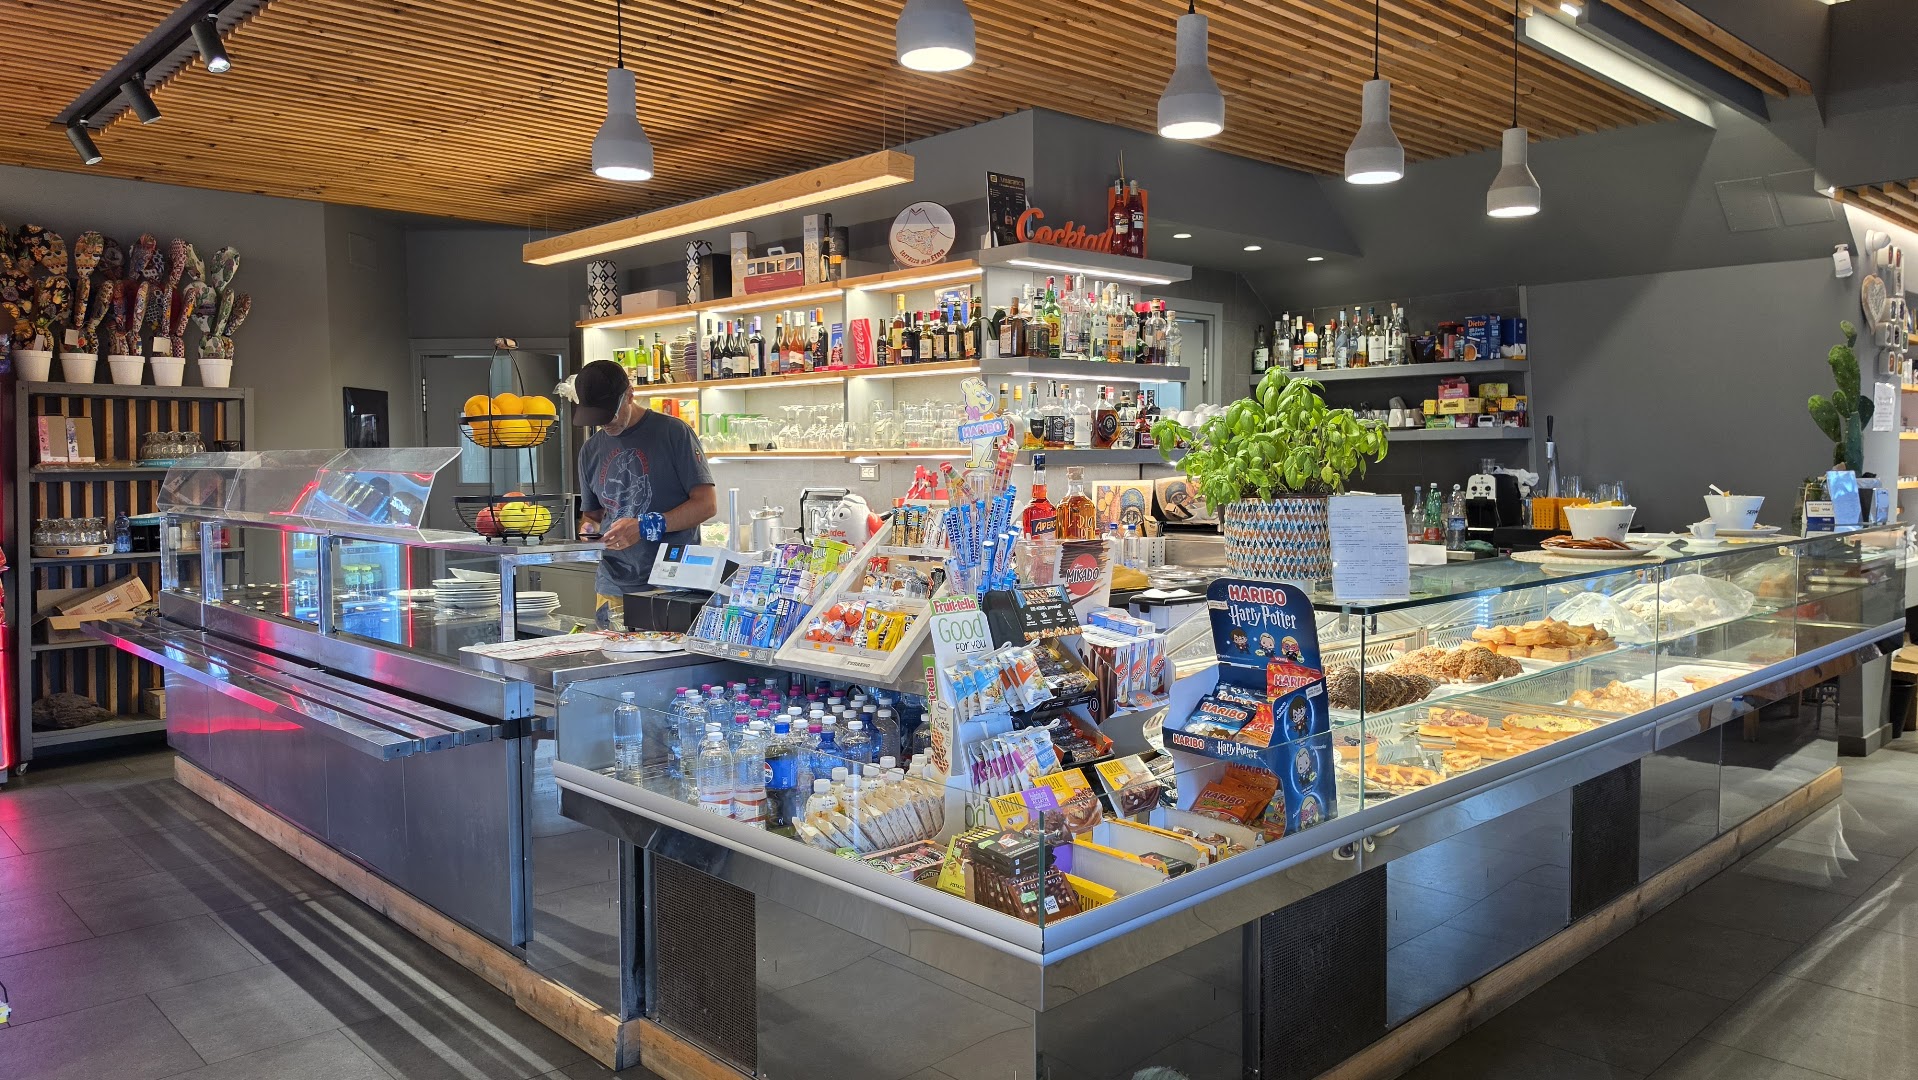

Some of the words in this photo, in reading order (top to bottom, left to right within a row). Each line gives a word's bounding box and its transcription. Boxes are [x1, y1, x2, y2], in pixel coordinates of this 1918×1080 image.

[1016, 207, 1113, 254] Cocktail
[962, 421, 1003, 439] HARIBO
[1066, 567, 1101, 584] MIKADO
[1228, 584, 1287, 606] HARIBO
[1228, 604, 1261, 629] Harry
[1260, 605, 1297, 632] Potter
[938, 613, 984, 643] Good
[1201, 702, 1248, 720] HARIBO
[1173, 733, 1205, 750] HARIBO
[1216, 740, 1236, 757] Harry
[1202, 790, 1246, 805] HARIBO
